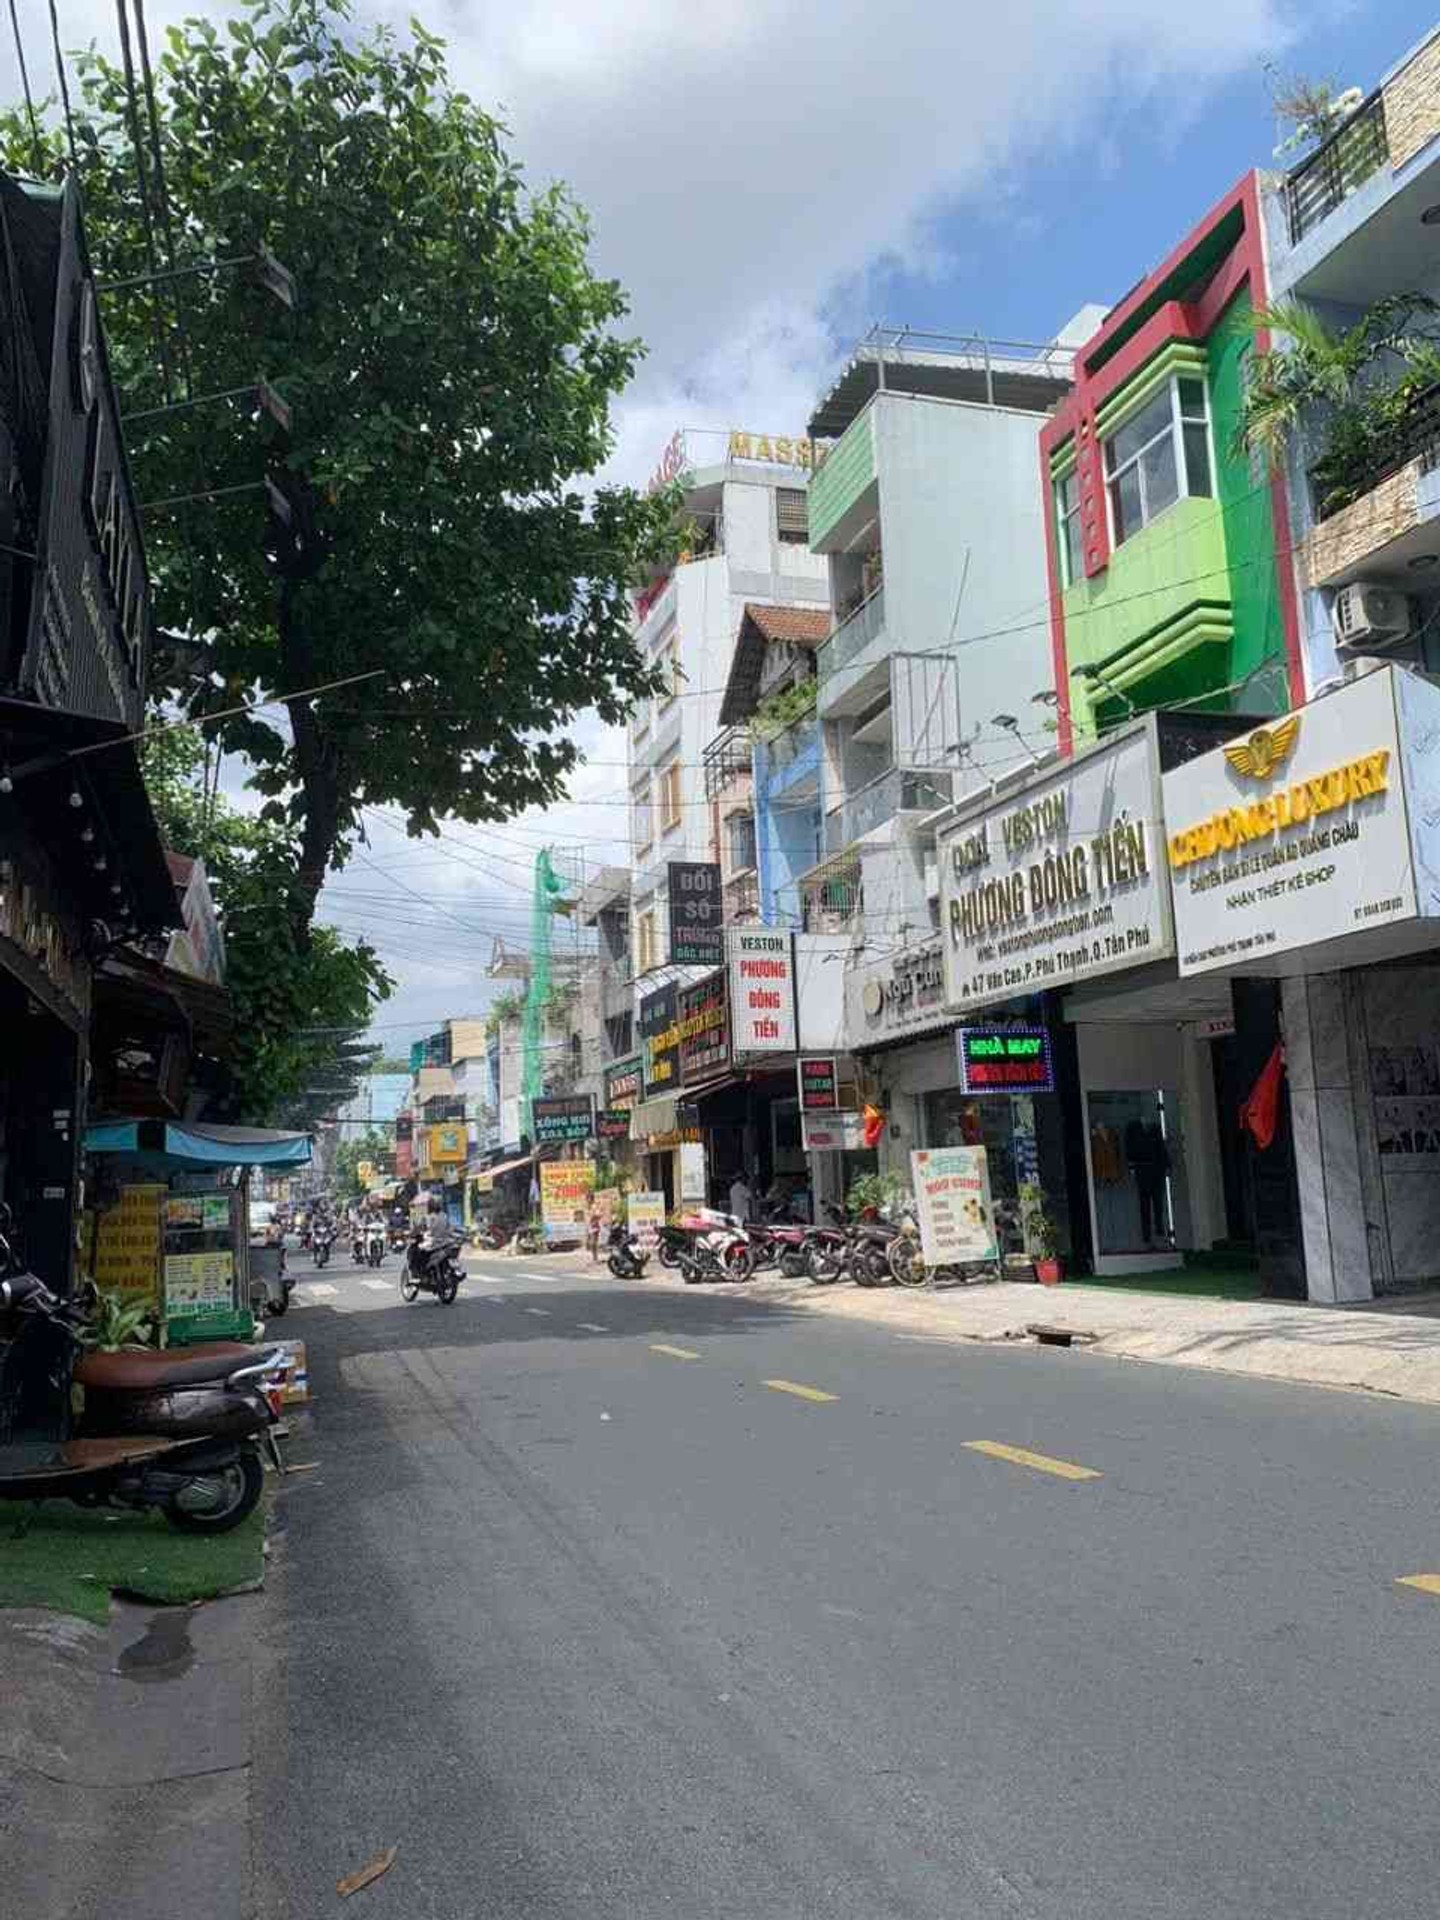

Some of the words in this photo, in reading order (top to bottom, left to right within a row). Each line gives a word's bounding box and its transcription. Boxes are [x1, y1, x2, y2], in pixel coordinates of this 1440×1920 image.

[1002, 789, 1067, 849] VESTON
[950, 871, 1025, 936] PHƯƠNG
[1092, 809, 1149, 886] TIẾN
[1306, 864, 1336, 888] SHOP
[741, 937, 784, 951] VESTON
[740, 959, 787, 979] PHƯƠNG
[748, 987, 780, 1009] ĐÔNG
[752, 1015, 779, 1038] TIẾN
